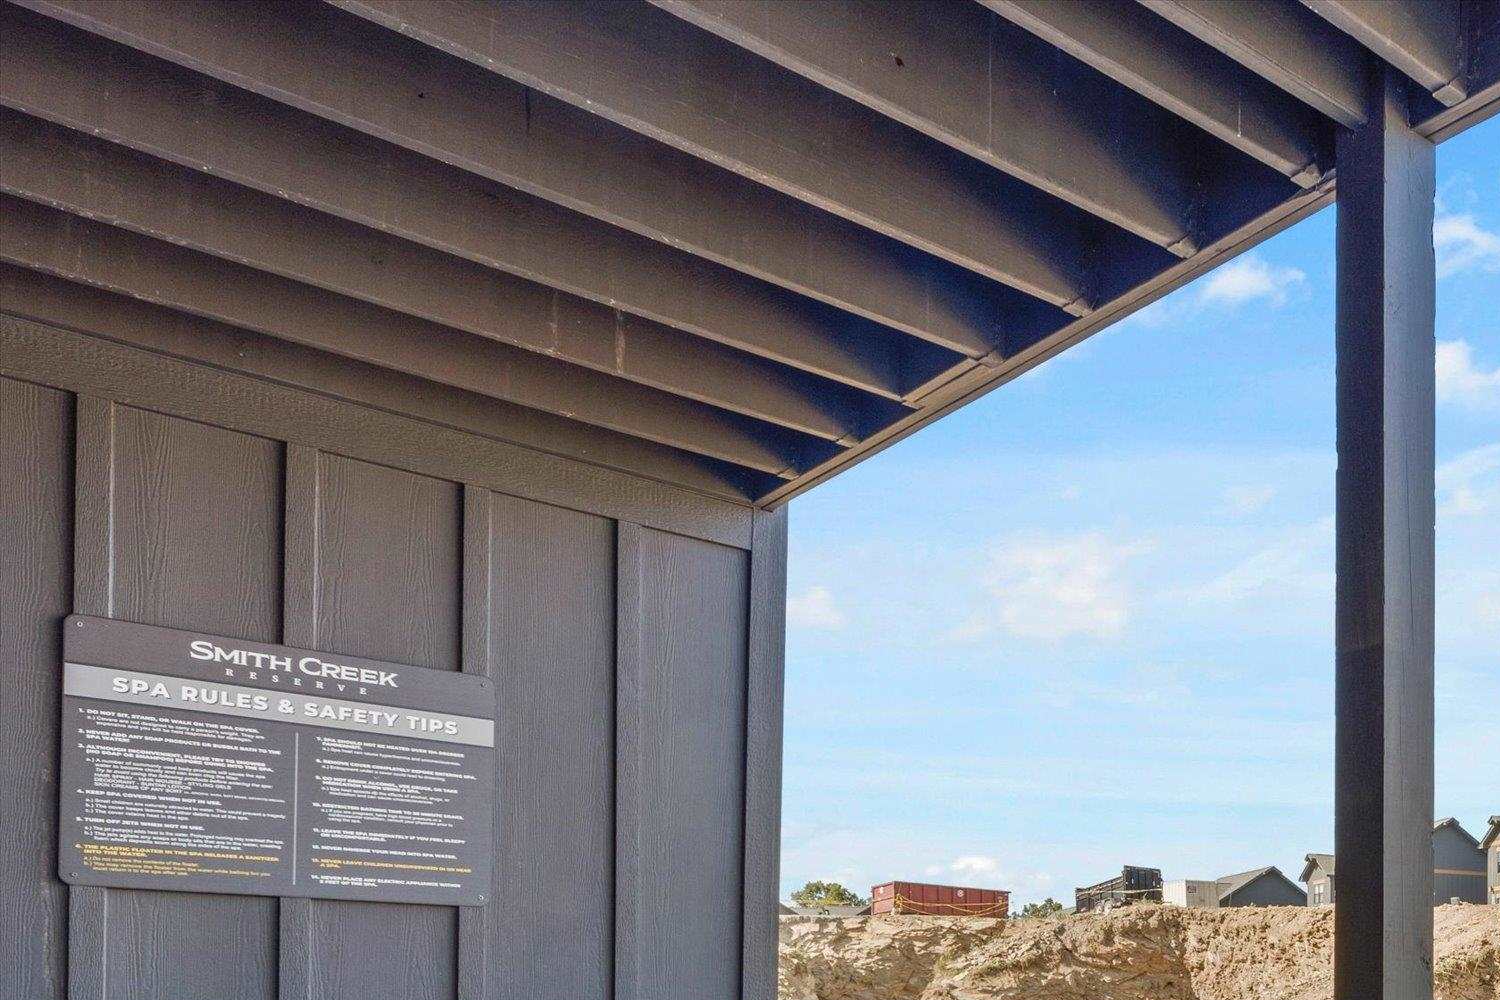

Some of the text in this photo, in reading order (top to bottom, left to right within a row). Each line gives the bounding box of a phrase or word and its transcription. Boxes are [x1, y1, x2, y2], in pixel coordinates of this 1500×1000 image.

[189, 639, 399, 687] SMITH CREEK
[224, 667, 370, 696] RESERVE
[111, 675, 459, 735] SPA RULES & SAFETY TIPS
